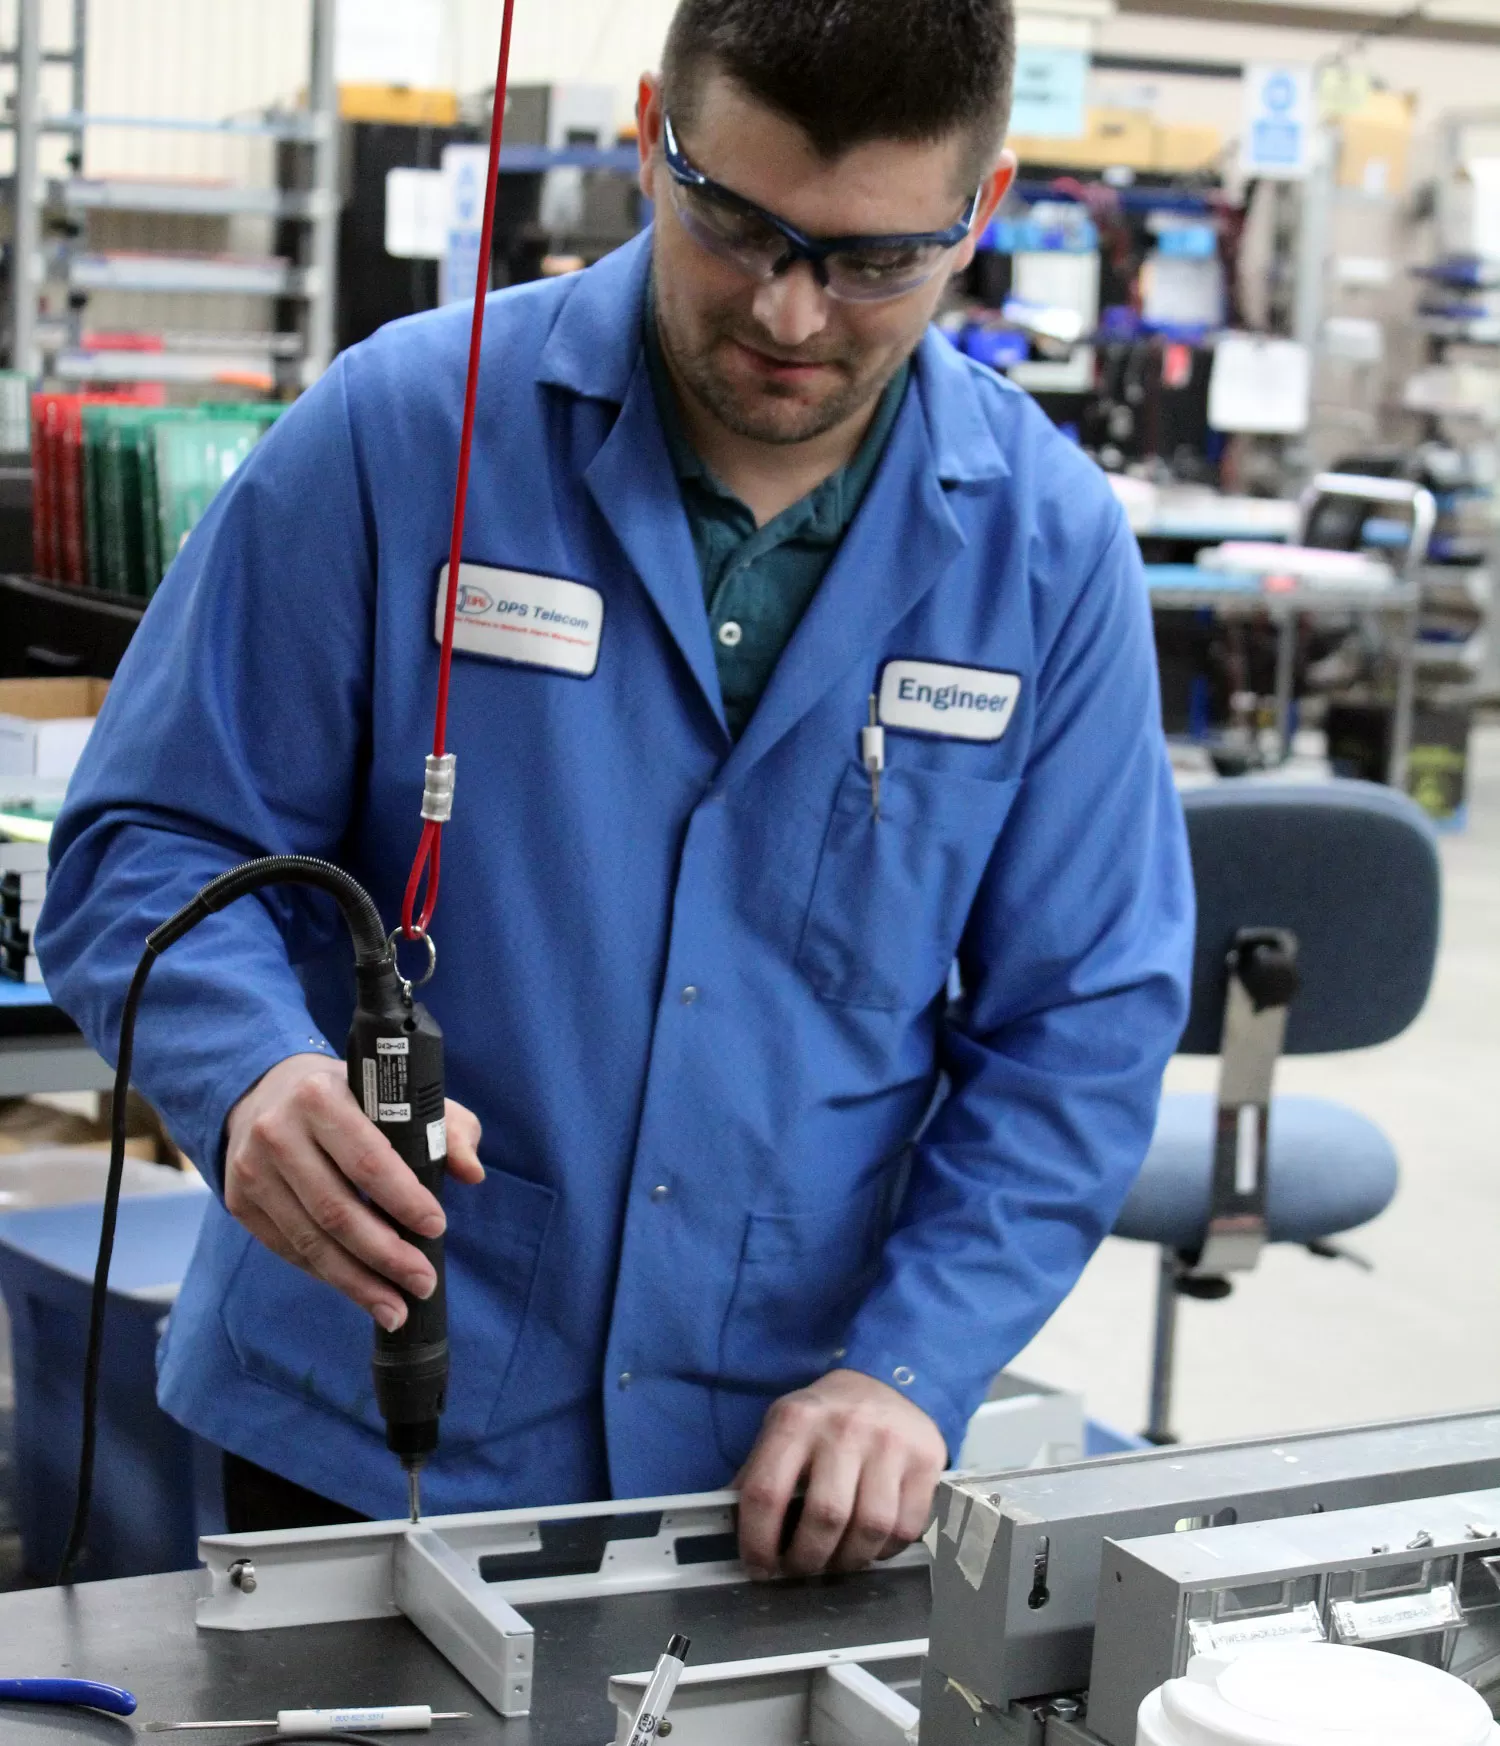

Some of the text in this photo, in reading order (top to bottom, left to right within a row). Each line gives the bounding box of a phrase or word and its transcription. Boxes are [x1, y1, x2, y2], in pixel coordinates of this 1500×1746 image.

[497, 600, 589, 630] DPS Telecom
[898, 677, 1009, 713] Engineer
